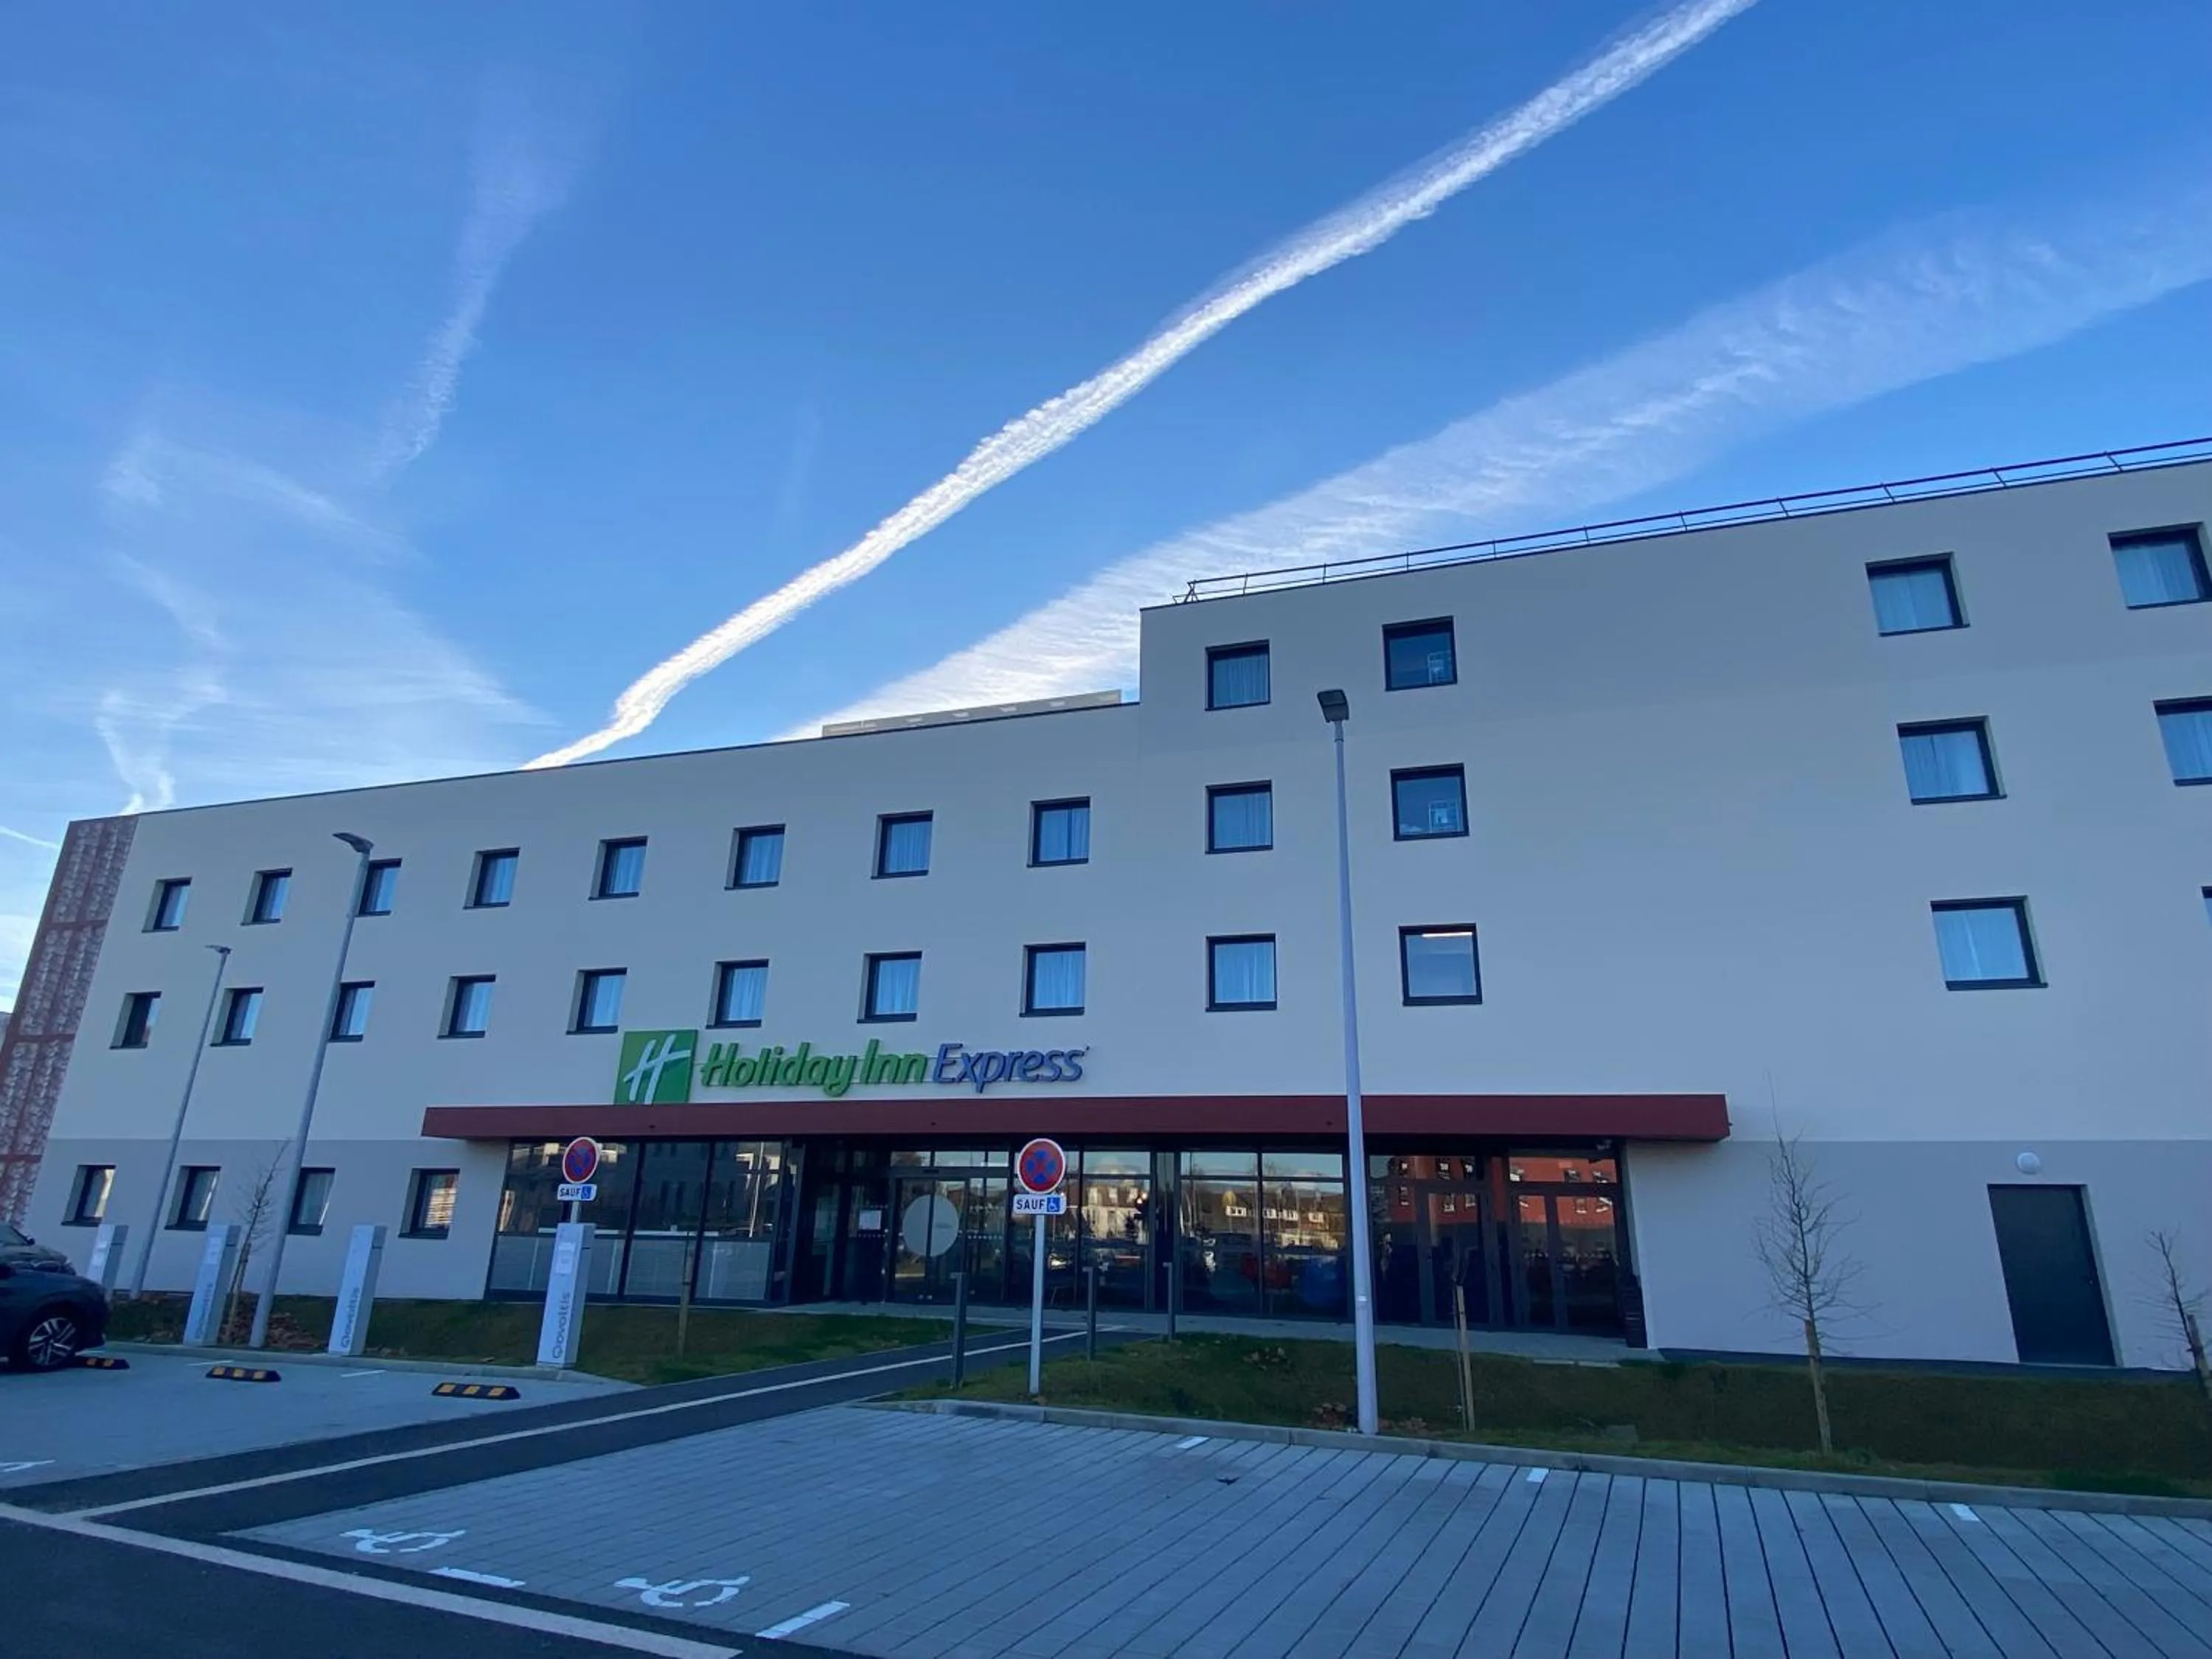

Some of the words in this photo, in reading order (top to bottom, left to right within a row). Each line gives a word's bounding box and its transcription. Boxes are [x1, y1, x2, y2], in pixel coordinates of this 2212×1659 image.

[700, 1042, 858, 1097] Holiday
[860, 1038, 929, 1084] Inn
[932, 1043, 1085, 1093] Express
[560, 1188, 580, 1197] SAUF
[1017, 1198, 1046, 1210] SAUF
